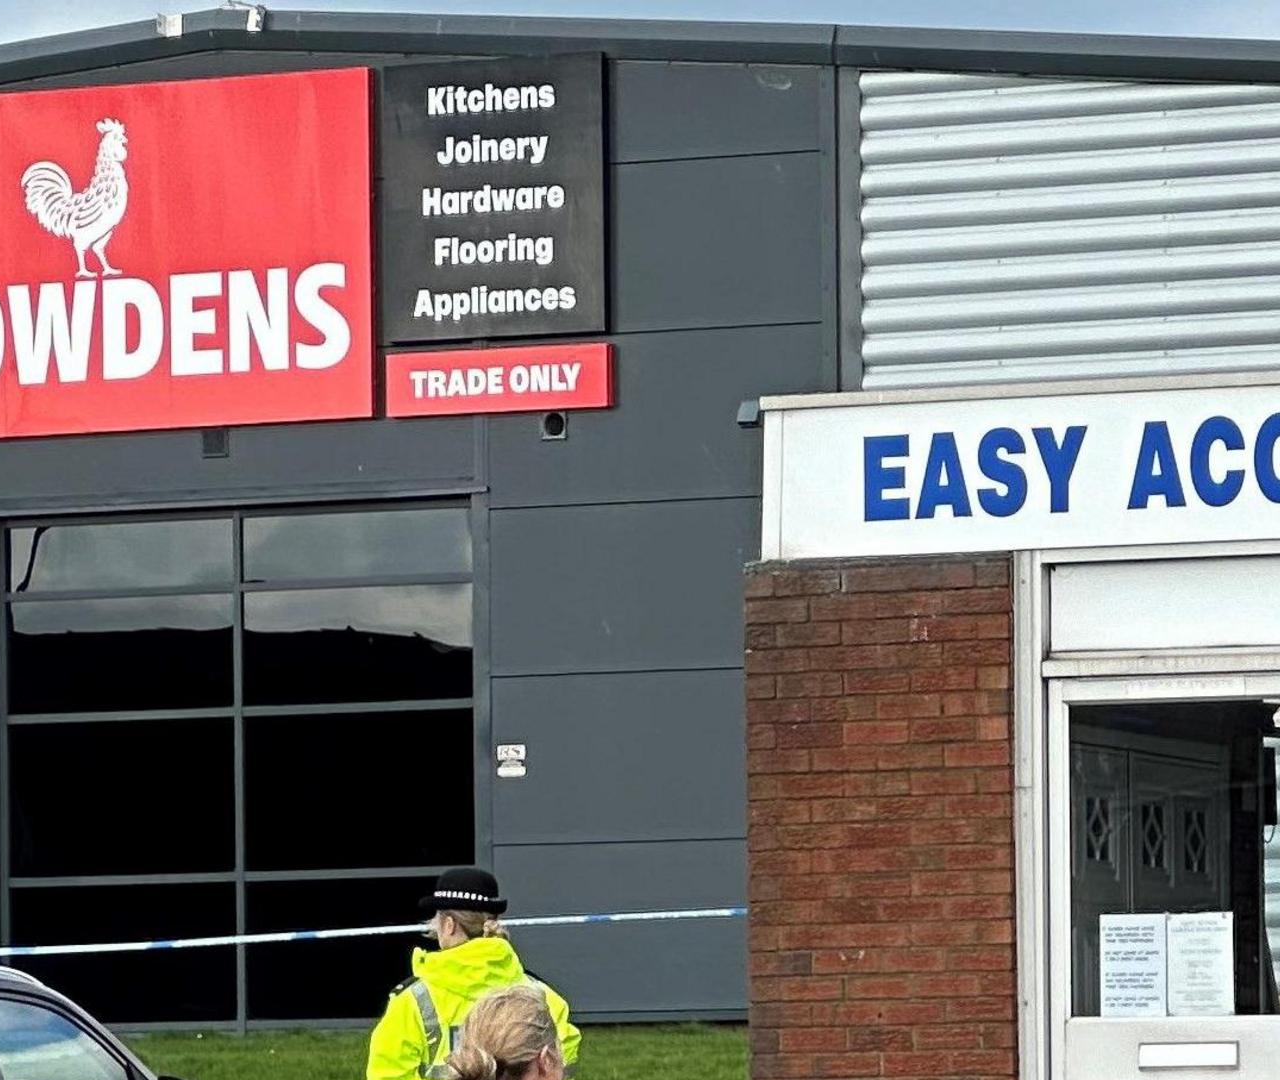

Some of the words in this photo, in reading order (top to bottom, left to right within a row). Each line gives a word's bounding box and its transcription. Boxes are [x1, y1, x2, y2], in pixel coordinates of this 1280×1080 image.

[427, 83, 555, 115] Kitchens
[437, 135, 548, 165] Joinery
[422, 184, 565, 216] Hardware
[434, 233, 554, 266] Flooring
[414, 285, 576, 321] Appliances
[410, 366, 503, 398] TRADE
[509, 363, 581, 392] ONLY
[864, 425, 1088, 521] EASY
